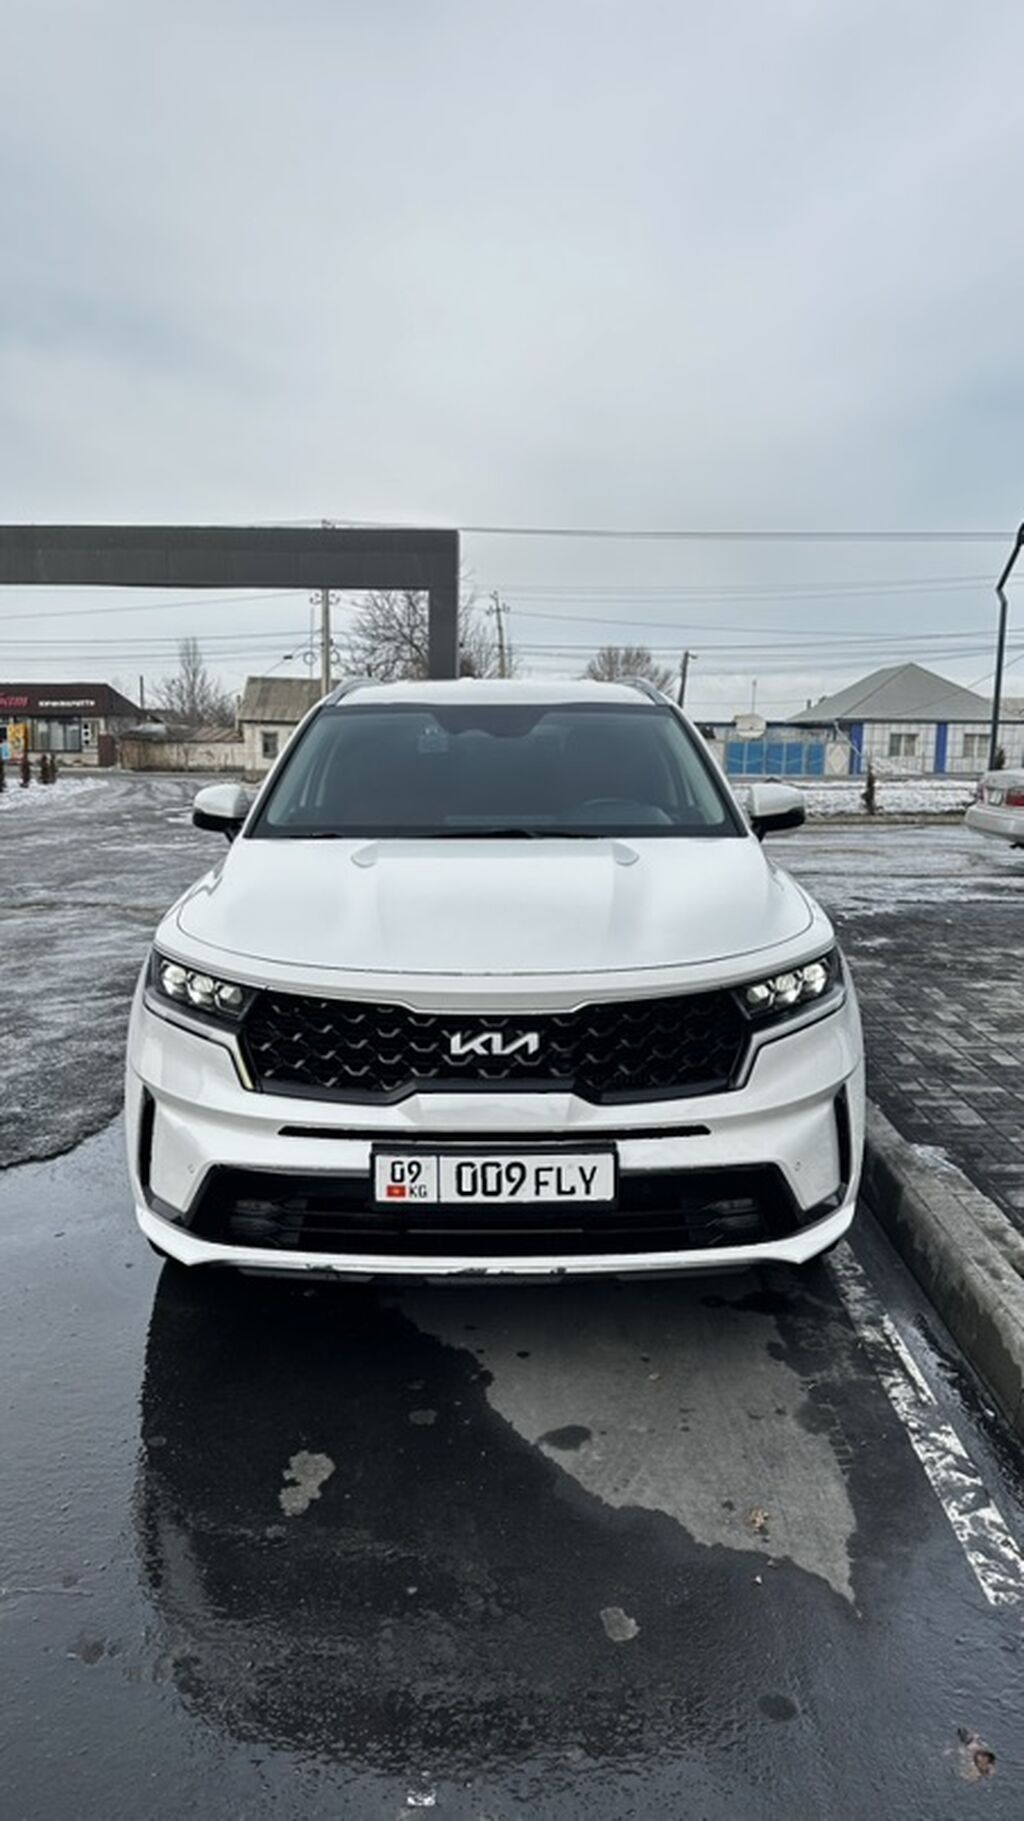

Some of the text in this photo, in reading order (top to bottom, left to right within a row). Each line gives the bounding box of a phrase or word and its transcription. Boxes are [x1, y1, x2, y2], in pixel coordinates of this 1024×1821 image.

[450, 1032, 539, 1055] KIA
[390, 1160, 597, 1197] 09 009 FLY
[408, 1185, 428, 1199] KG
